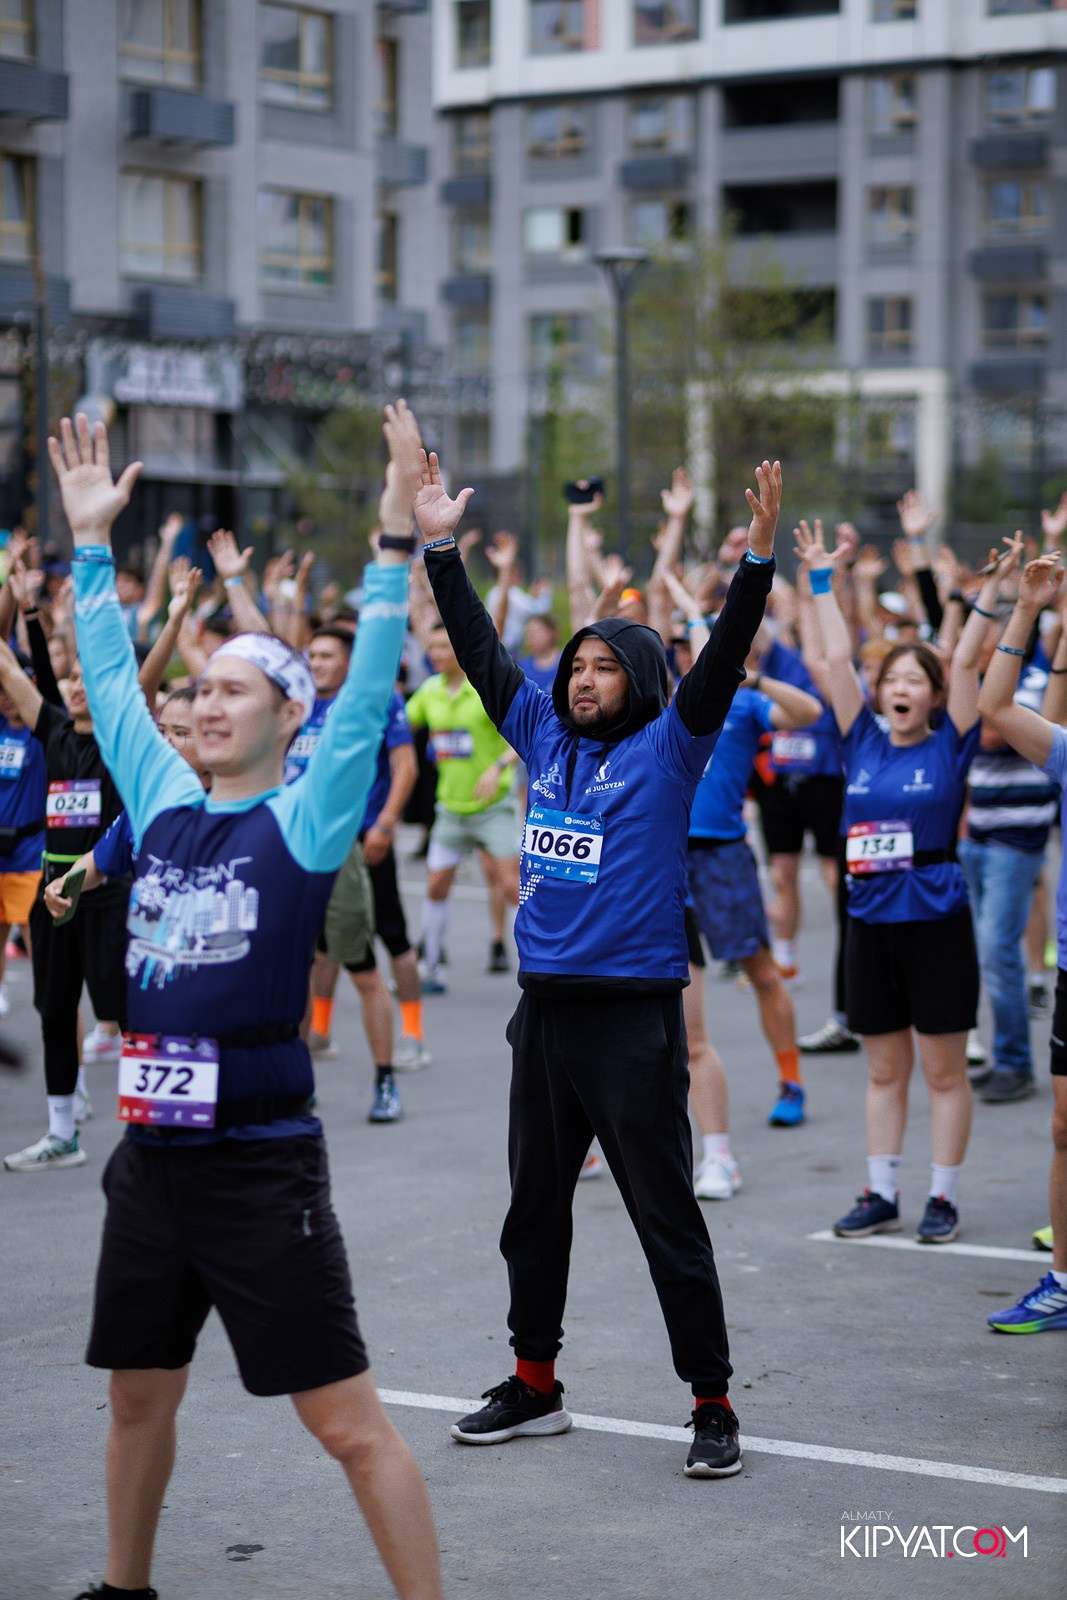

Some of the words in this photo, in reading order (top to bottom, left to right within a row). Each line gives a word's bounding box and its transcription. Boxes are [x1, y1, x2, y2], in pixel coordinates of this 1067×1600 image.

[592, 780, 625, 792] JULDYZAI
[55, 794, 89, 811] 024
[572, 818, 591, 826] GROUP
[530, 829, 594, 859] 1066
[860, 835, 896, 855] 134
[135, 1064, 194, 1095] 372
